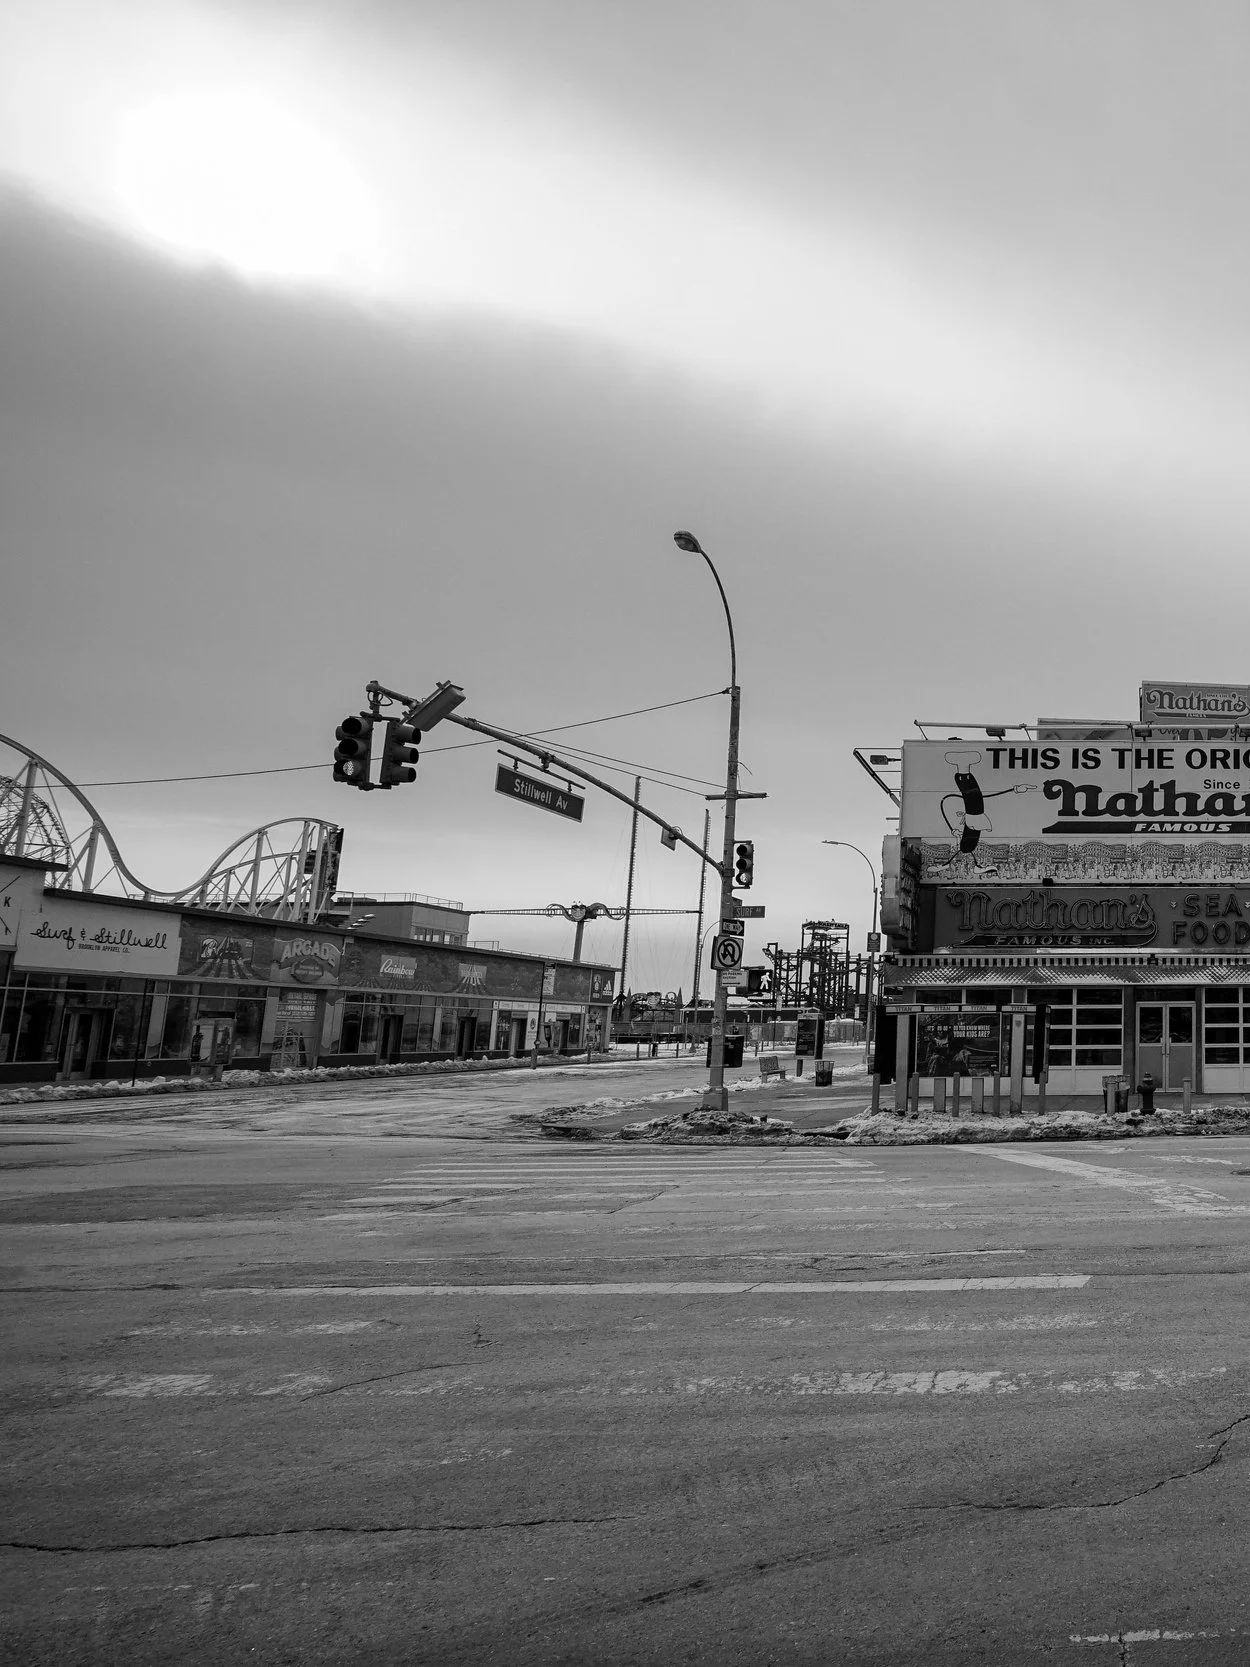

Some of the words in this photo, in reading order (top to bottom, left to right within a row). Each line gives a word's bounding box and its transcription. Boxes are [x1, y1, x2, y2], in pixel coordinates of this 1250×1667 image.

[1146, 689, 1247, 712] Nathan's
[986, 747, 1060, 770] THIS
[1071, 748, 1101, 770] IS
[1111, 748, 1174, 770] THE
[513, 778, 552, 805] Stillwell
[555, 795, 568, 810] Av
[1203, 778, 1241, 790] Since
[1134, 822, 1232, 833] FAMOUS
[736, 907, 753, 917] SURF
[947, 888, 1156, 930] Nathan's
[1183, 893, 1243, 918] SEA
[30, 921, 76, 950] Surf
[90, 927, 167, 949] Stillwell
[994, 935, 1083, 945] FAMOUS
[1089, 936, 1115, 945] INC.
[78, 943, 100, 951] BROOKLYN
[102, 944, 120, 952] APPAREL
[280, 937, 336, 968] ARCADE
[379, 958, 416, 976] Rainbow
